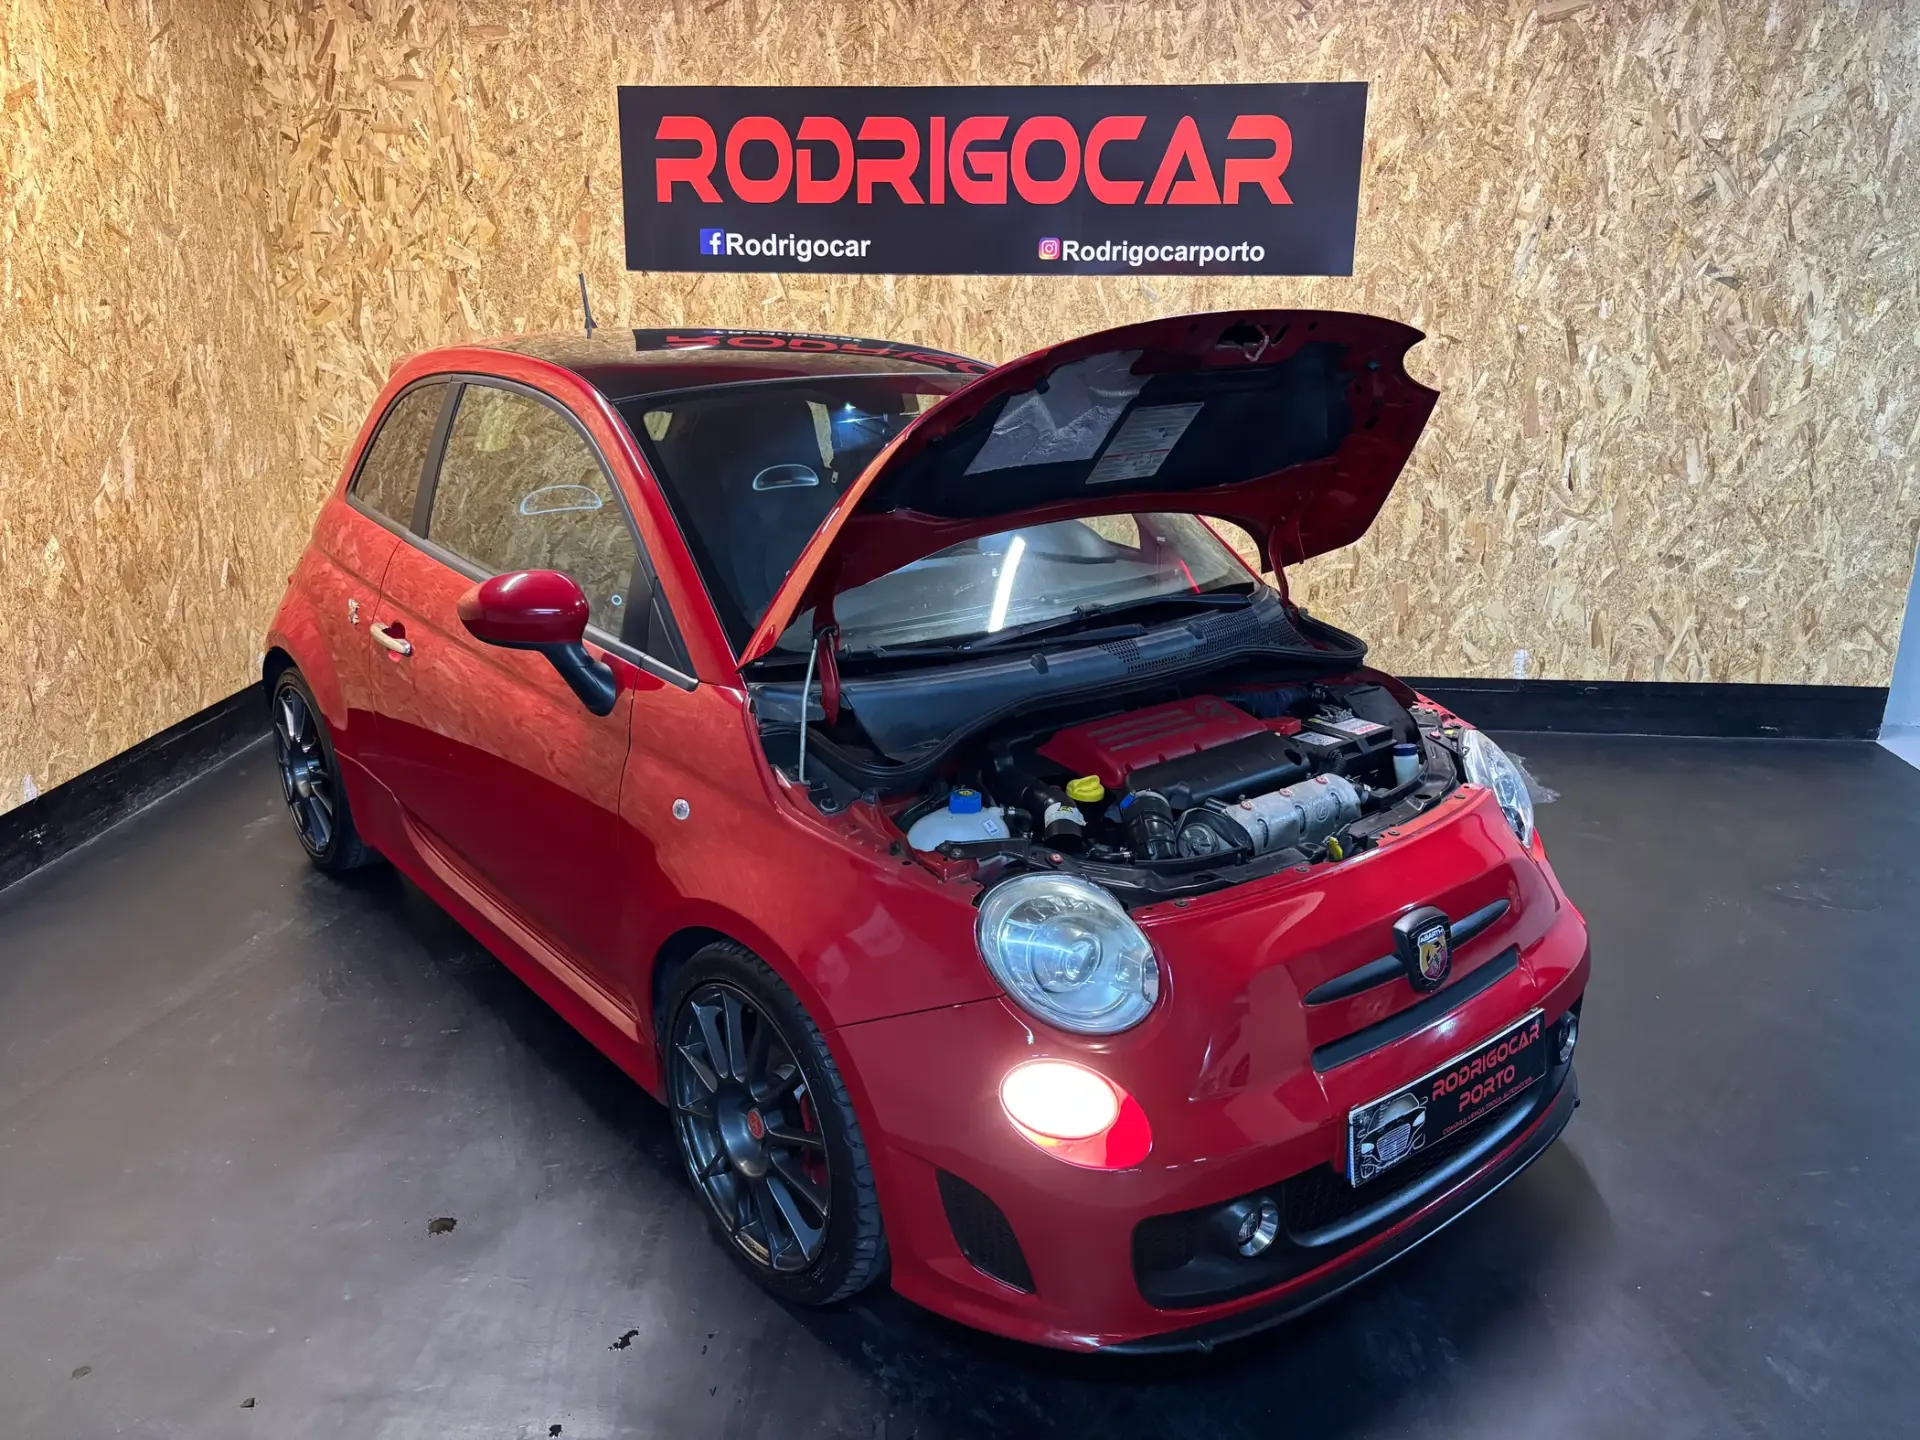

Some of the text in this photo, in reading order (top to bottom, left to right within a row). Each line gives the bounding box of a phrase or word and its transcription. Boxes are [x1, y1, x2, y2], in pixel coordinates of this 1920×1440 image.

[655, 115, 1294, 205] RODRIGOCAR
[725, 233, 871, 262] Rodrigocar
[1062, 240, 1265, 266] Rodrigocarporto
[1420, 928, 1444, 943] ABARTH
[1431, 1023, 1540, 1101] RODRIGOCAR
[1458, 1064, 1516, 1112] PORTO
